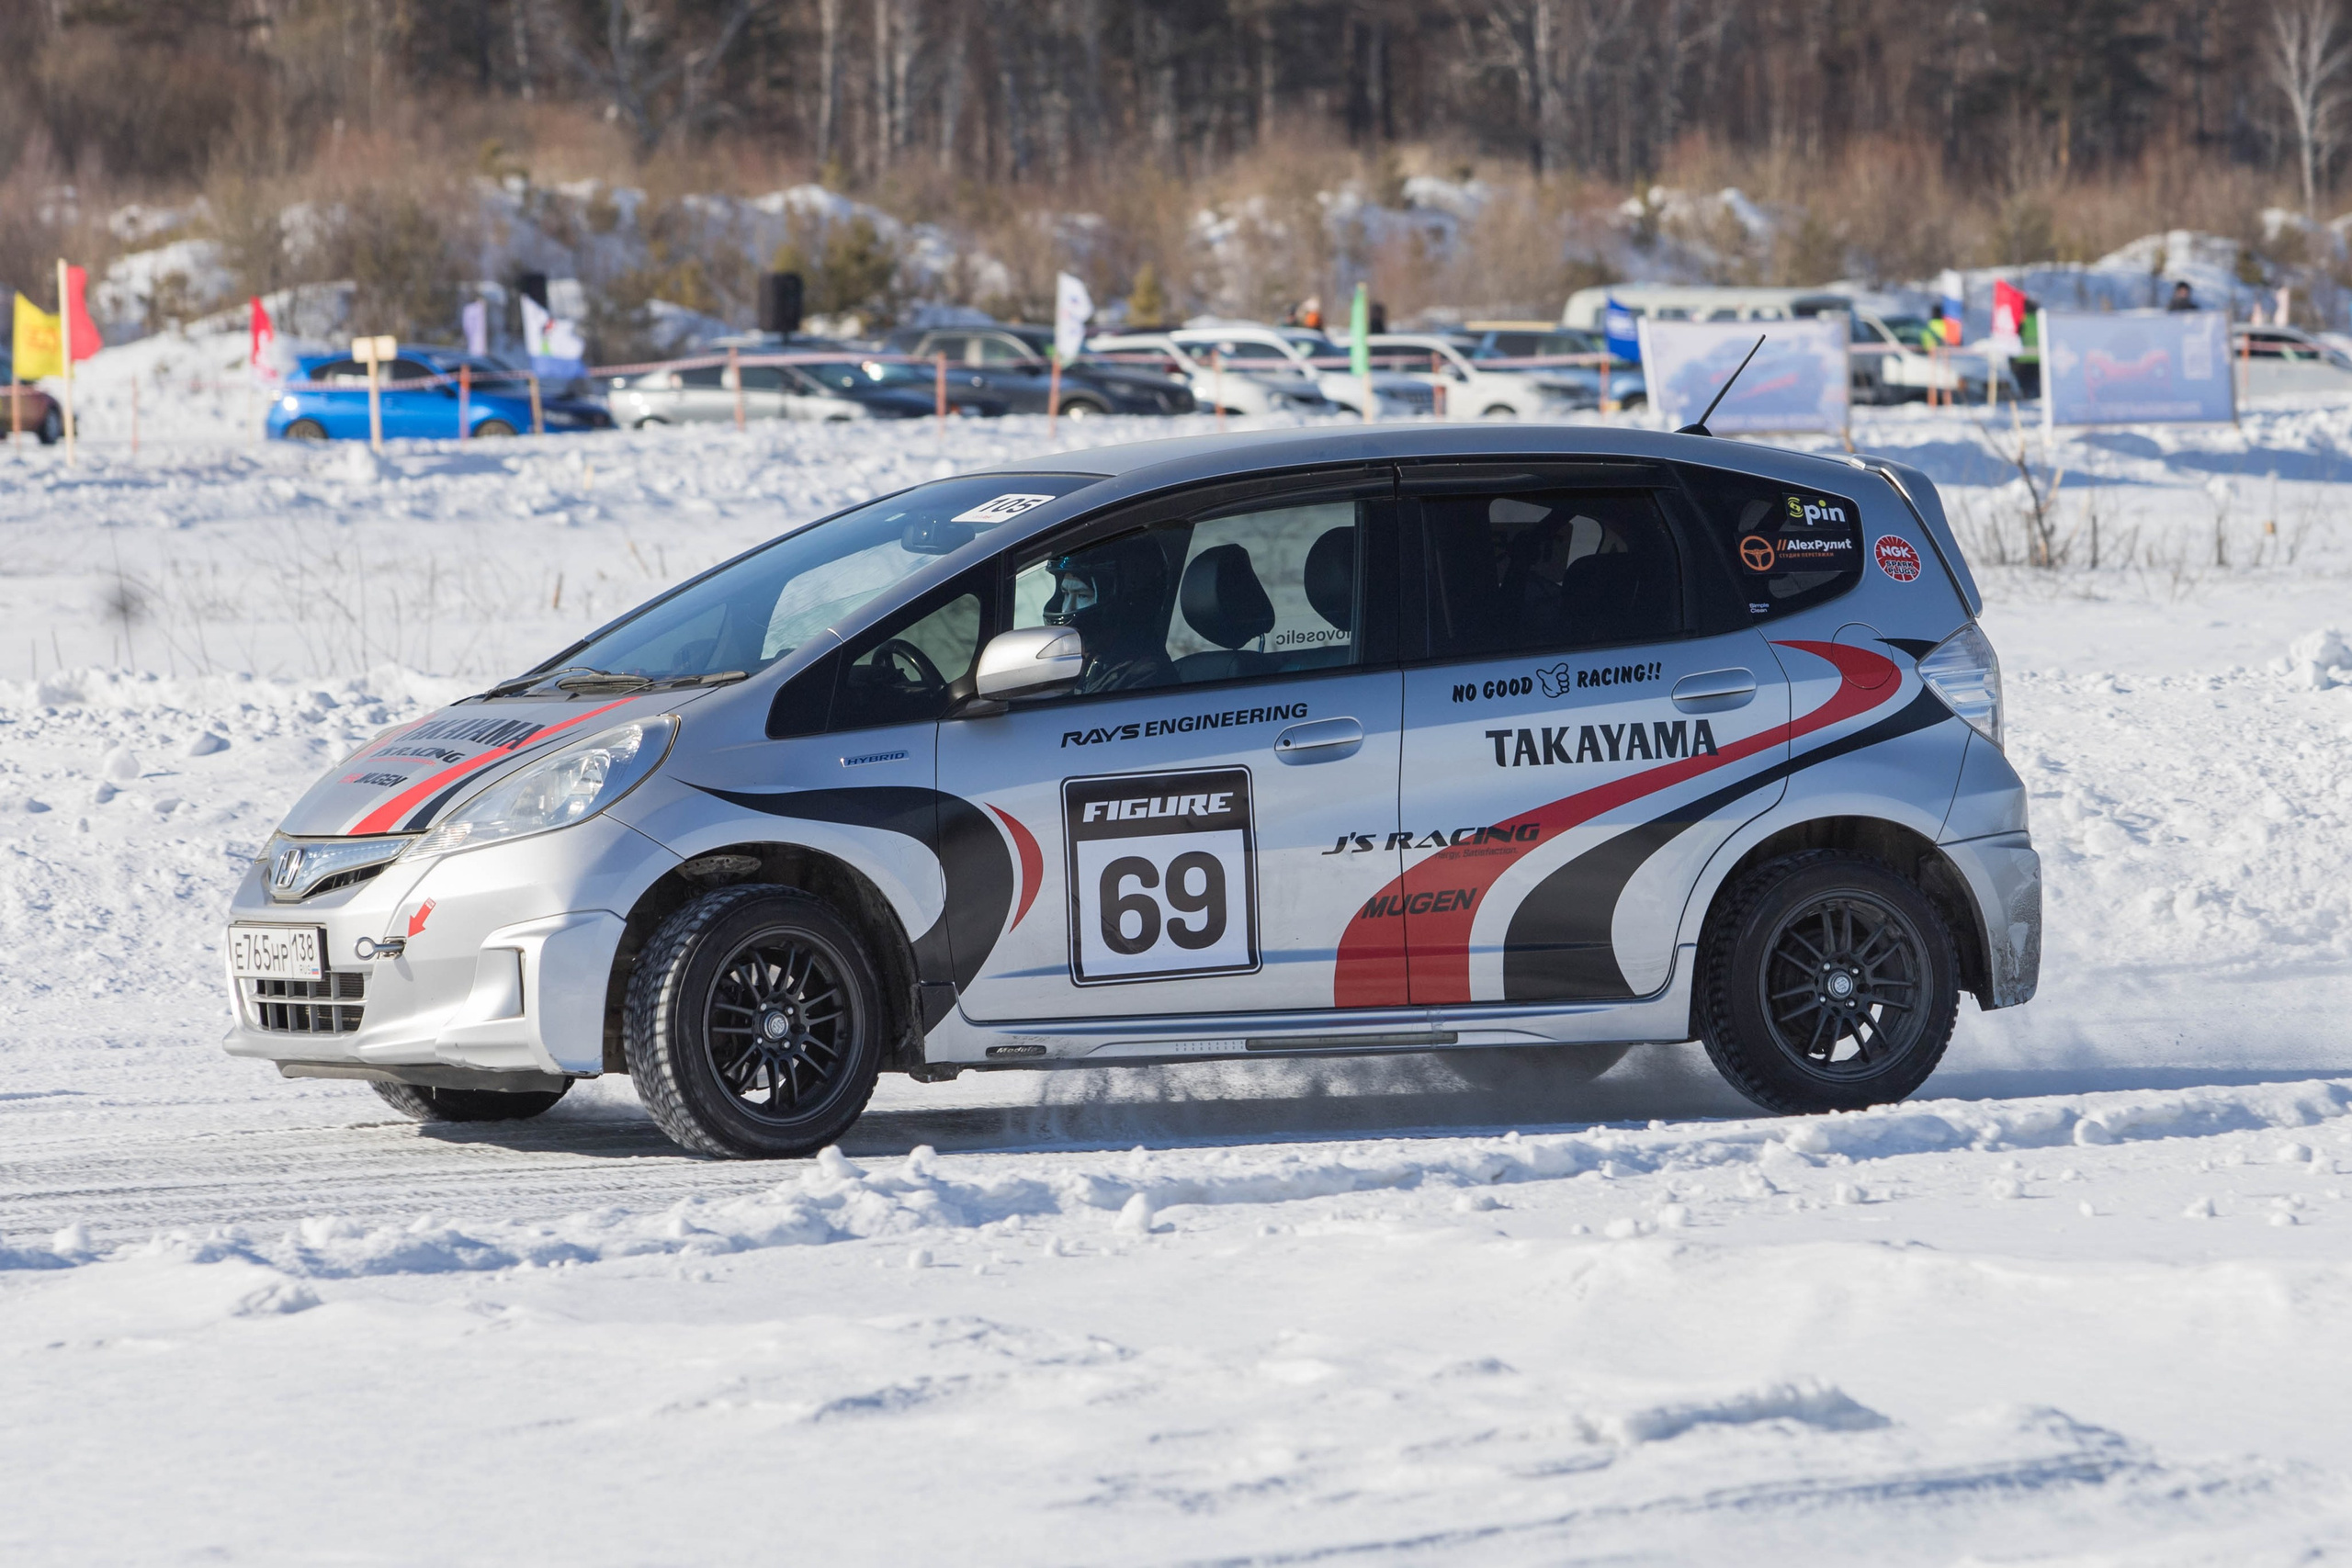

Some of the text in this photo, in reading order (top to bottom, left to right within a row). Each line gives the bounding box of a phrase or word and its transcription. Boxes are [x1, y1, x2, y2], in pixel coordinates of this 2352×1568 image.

[978, 497, 1043, 513] 105
[1788, 496, 1846, 525] Spin
[1880, 546, 1911, 558] NGK
[1887, 567, 1917, 575] PLUGS
[1453, 662, 1662, 703] NO GOOD RACING!!
[1061, 703, 1307, 748] RAYS ENGINEERING
[1486, 719, 1719, 767] TAKAYAMA
[847, 752, 905, 765] HYBRID
[353, 773, 408, 787] MUGEN
[1082, 792, 1234, 823] FIGURE
[1321, 823, 1540, 855] J'S RACING
[1100, 851, 1227, 955] 69
[1362, 887, 1477, 919] MUGEN
[291, 933, 314, 962] 138
